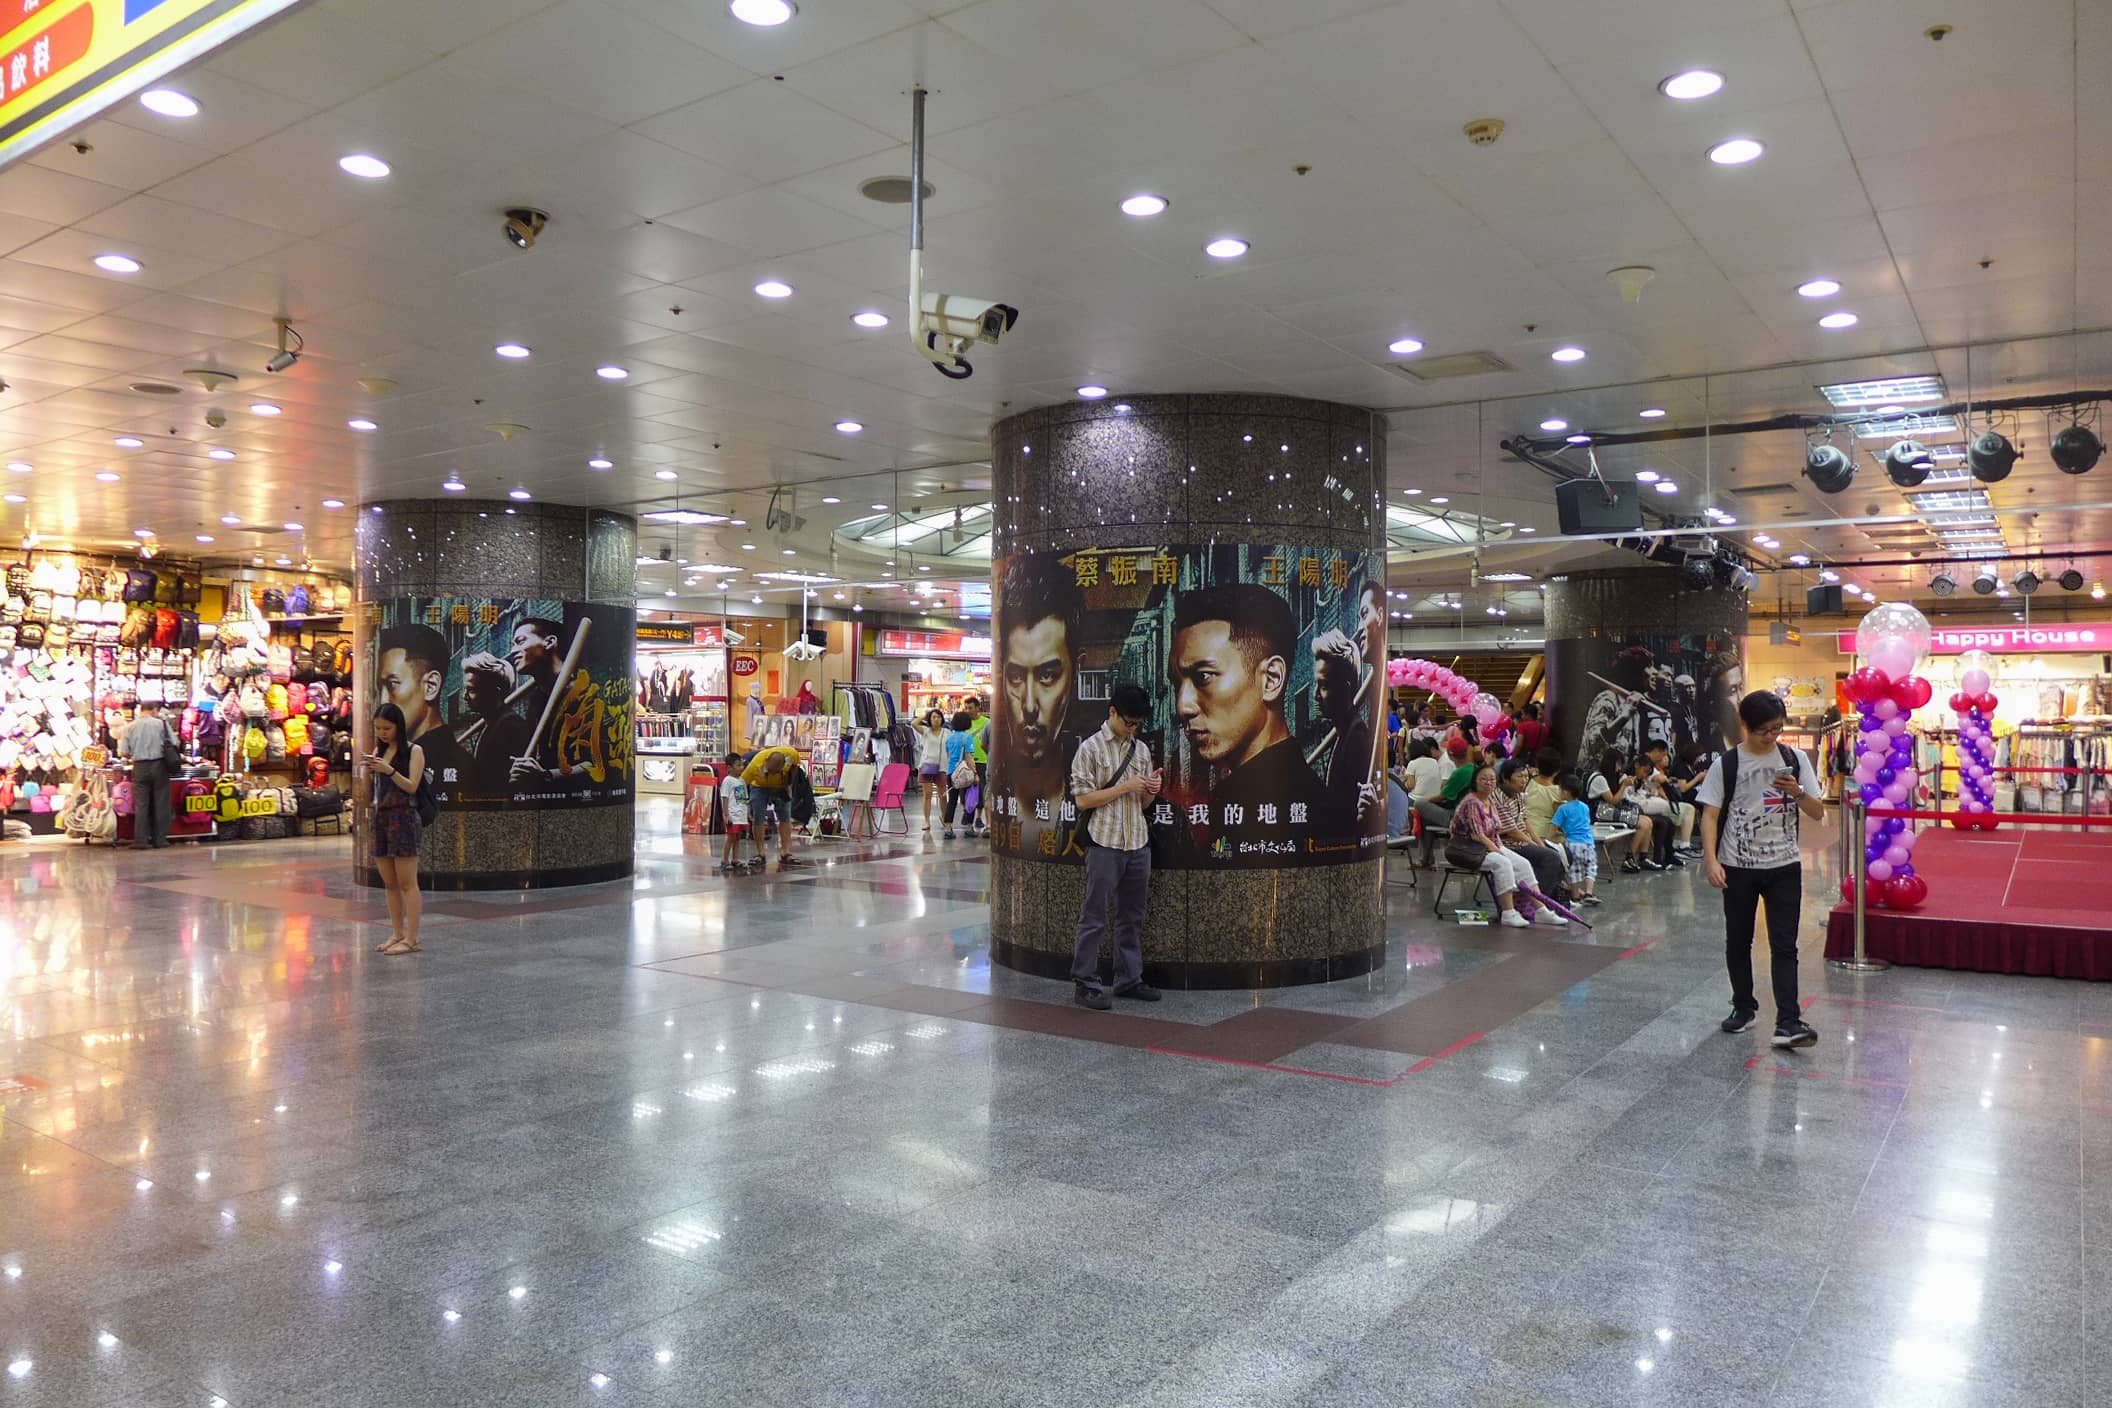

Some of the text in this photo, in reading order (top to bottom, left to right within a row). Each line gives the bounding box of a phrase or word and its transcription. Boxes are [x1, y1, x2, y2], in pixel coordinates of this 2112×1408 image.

[0, 34, 50, 100] 飲料
[1076, 555, 1178, 588] 蔡振南
[1263, 555, 1349, 589] 王陽明
[425, 604, 499, 625] 王陽明
[1931, 629, 2095, 647] Happy House
[735, 660, 755, 672] EEC
[188, 797, 215, 811] 100
[243, 800, 272, 814] 100
[1153, 802, 1308, 825] 是我的地盤
